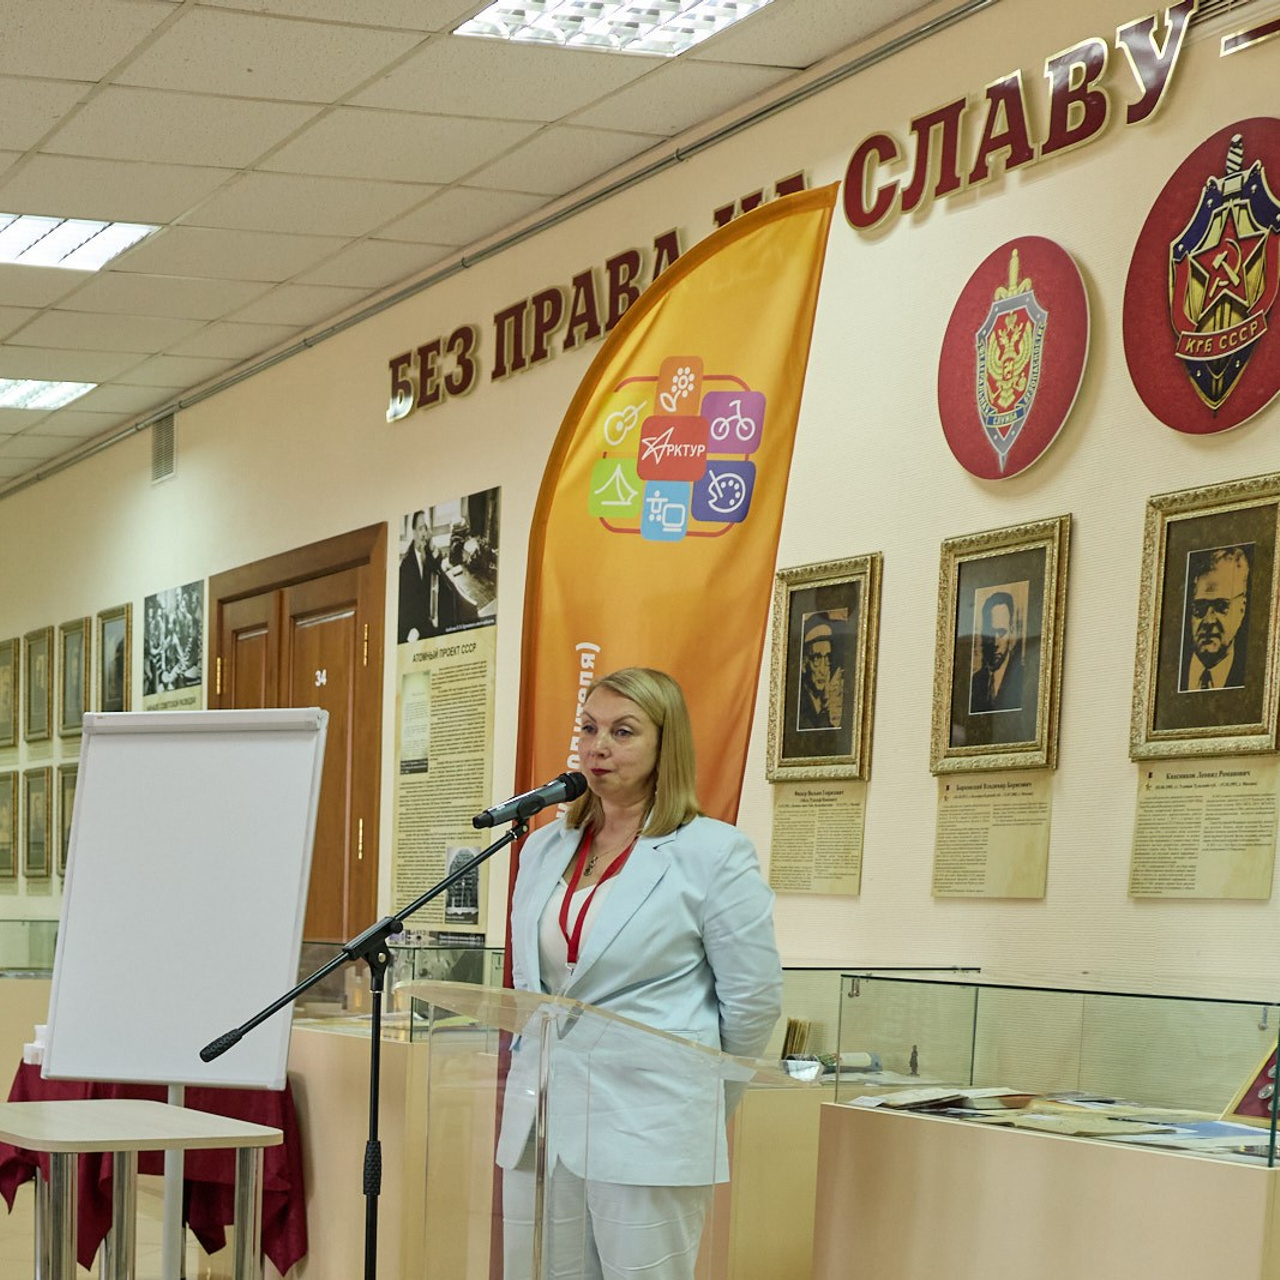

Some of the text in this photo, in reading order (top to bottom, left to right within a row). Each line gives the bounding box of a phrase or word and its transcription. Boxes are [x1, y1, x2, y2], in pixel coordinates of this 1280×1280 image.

[386, 324, 480, 423] БЕЗ
[843, 0, 1199, 232] СЛАВУ
[1185, 320, 1258, 353] КГБ СССР
[461, 642, 477, 654] СССР
[315, 669, 326, 686] 34
